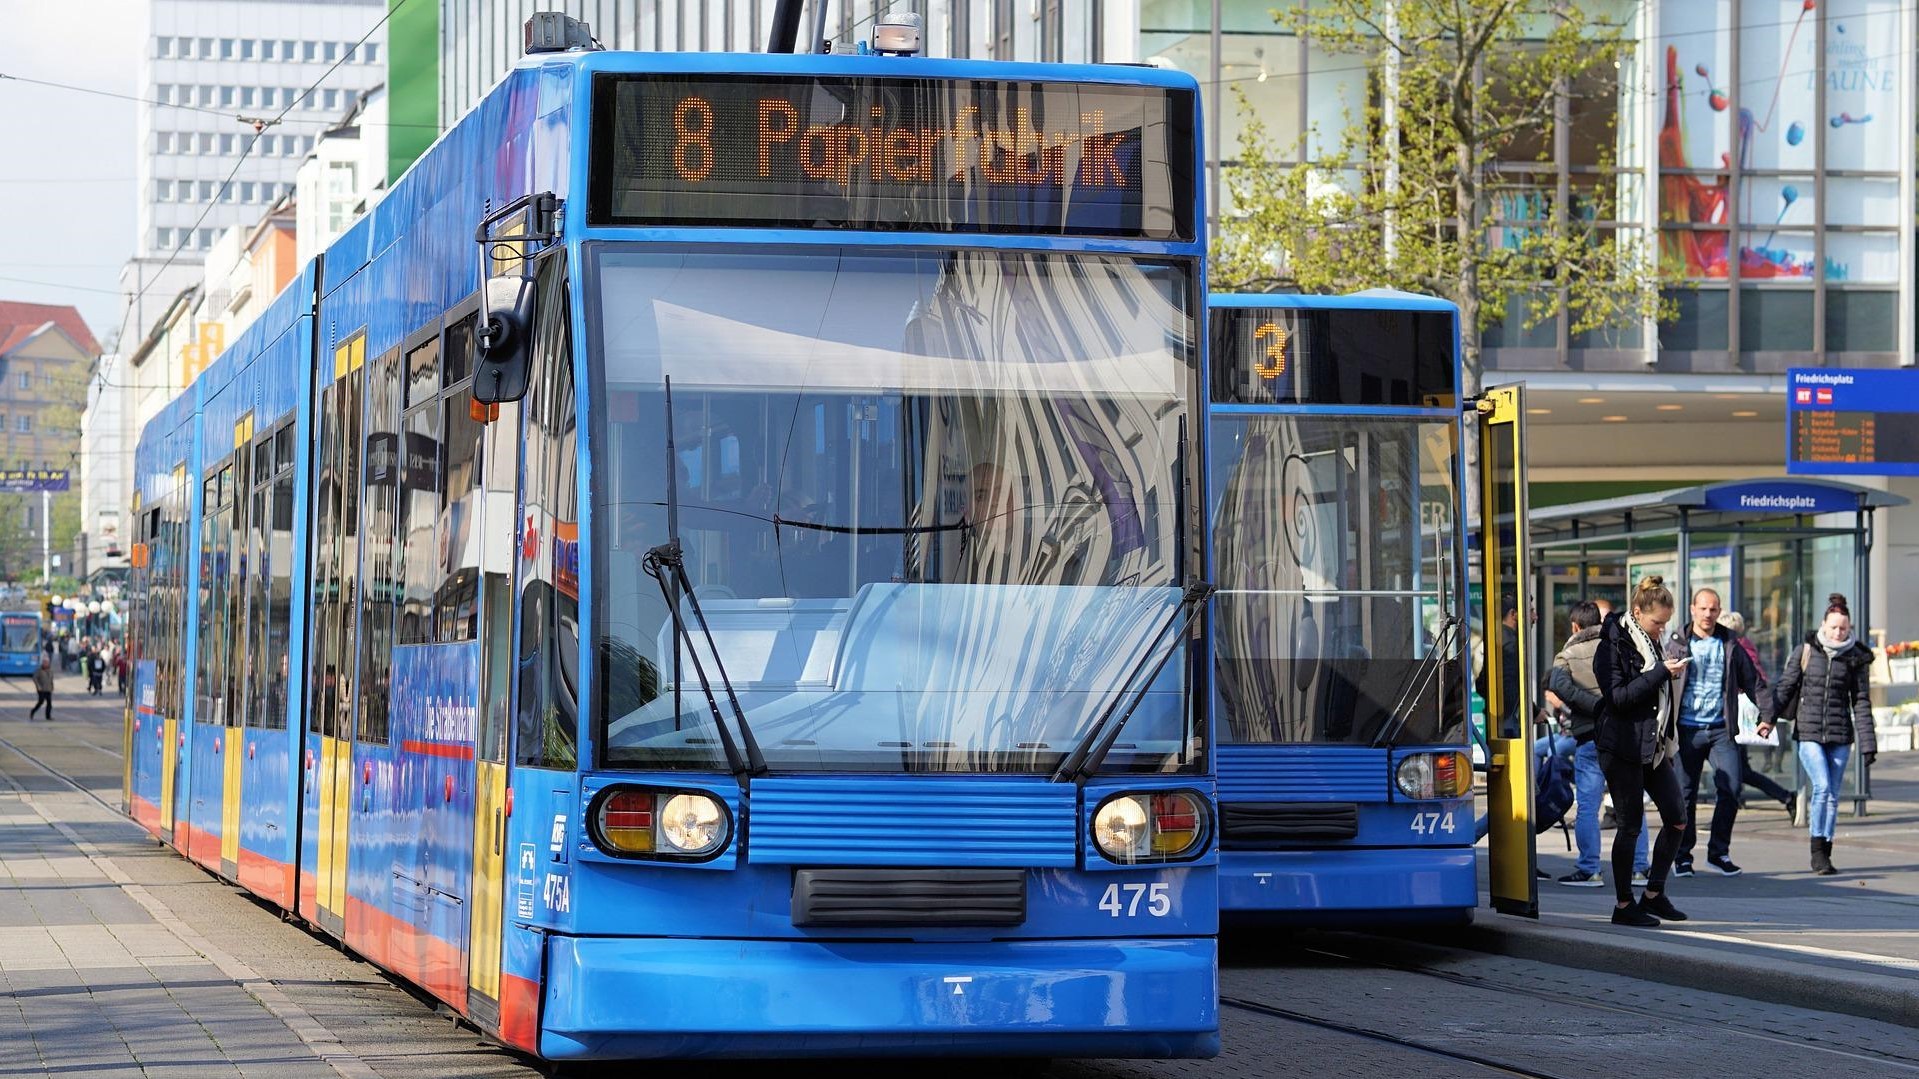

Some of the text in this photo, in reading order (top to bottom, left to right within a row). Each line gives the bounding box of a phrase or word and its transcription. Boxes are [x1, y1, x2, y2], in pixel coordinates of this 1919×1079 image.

[673, 96, 1128, 188] 8 Papierfabrik
[1254, 322, 1286, 379] 3
[1795, 374, 1854, 385] Friedrichsplatz
[1740, 495, 1816, 510] Friedrichsplatz
[1410, 812, 1455, 835] 474
[543, 873, 570, 913] 475A
[1098, 883, 1172, 918] 475
